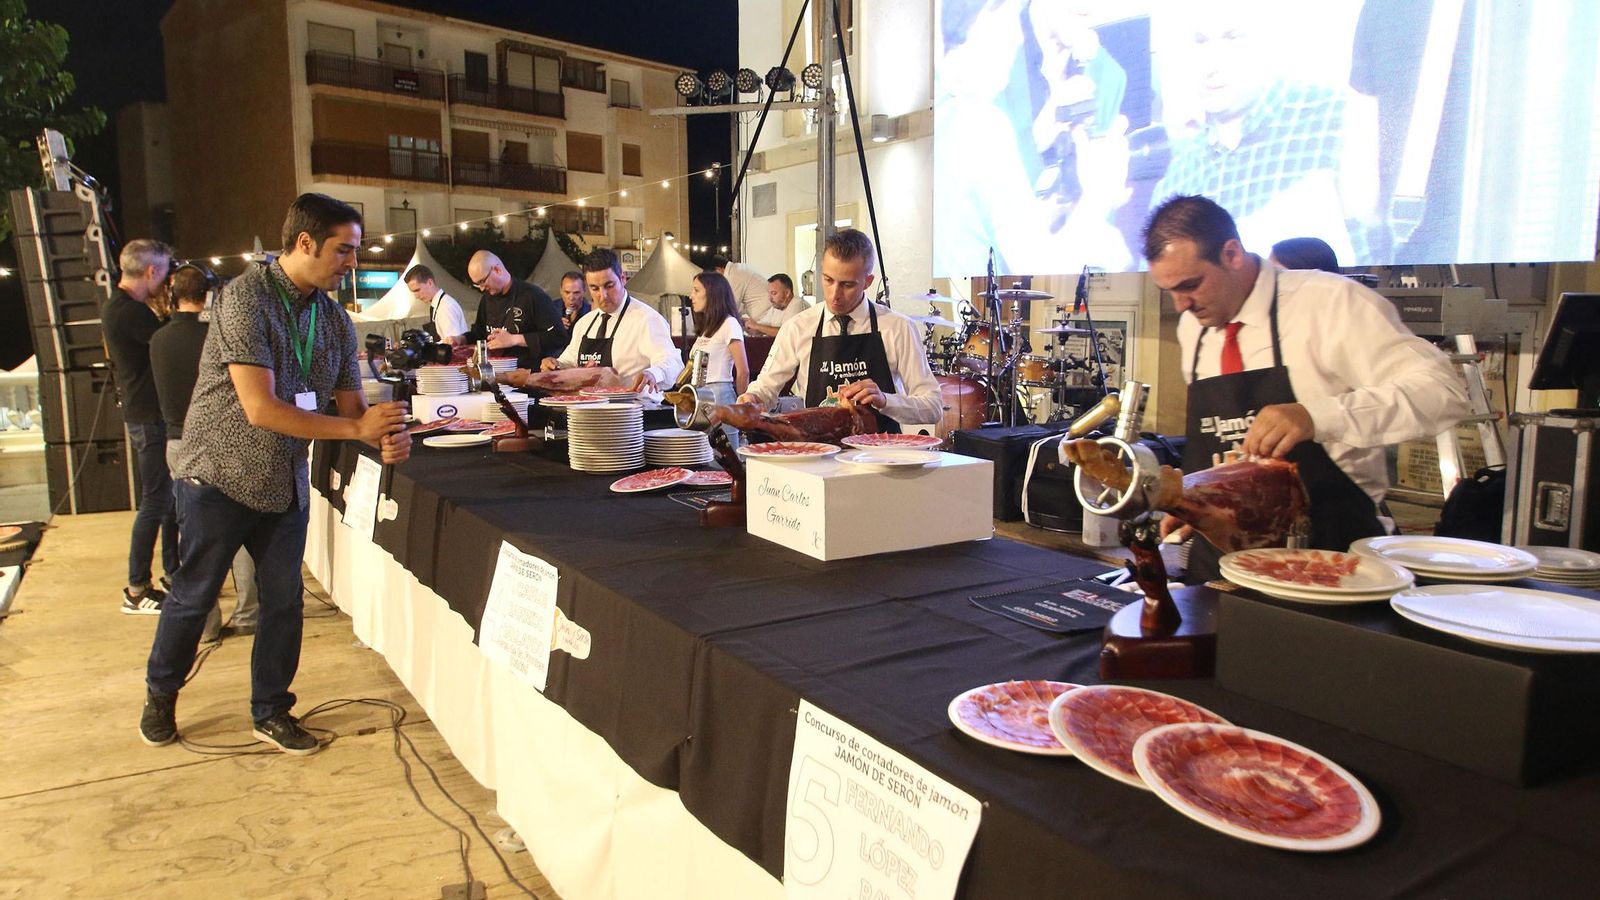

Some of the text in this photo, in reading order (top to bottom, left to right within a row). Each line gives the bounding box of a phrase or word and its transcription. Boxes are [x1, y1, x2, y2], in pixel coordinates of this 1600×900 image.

[829, 357, 867, 376] Jamón
[758, 477, 811, 508] Juan Carlos
[767, 506, 801, 531] Garrido
[804, 711, 969, 821] Concurso de cortadores de jamón
[872, 767, 885, 786] DE
[788, 755, 841, 886] 5
[845, 778, 945, 871] FERNANDO
[859, 832, 918, 899] LÓPEZ
